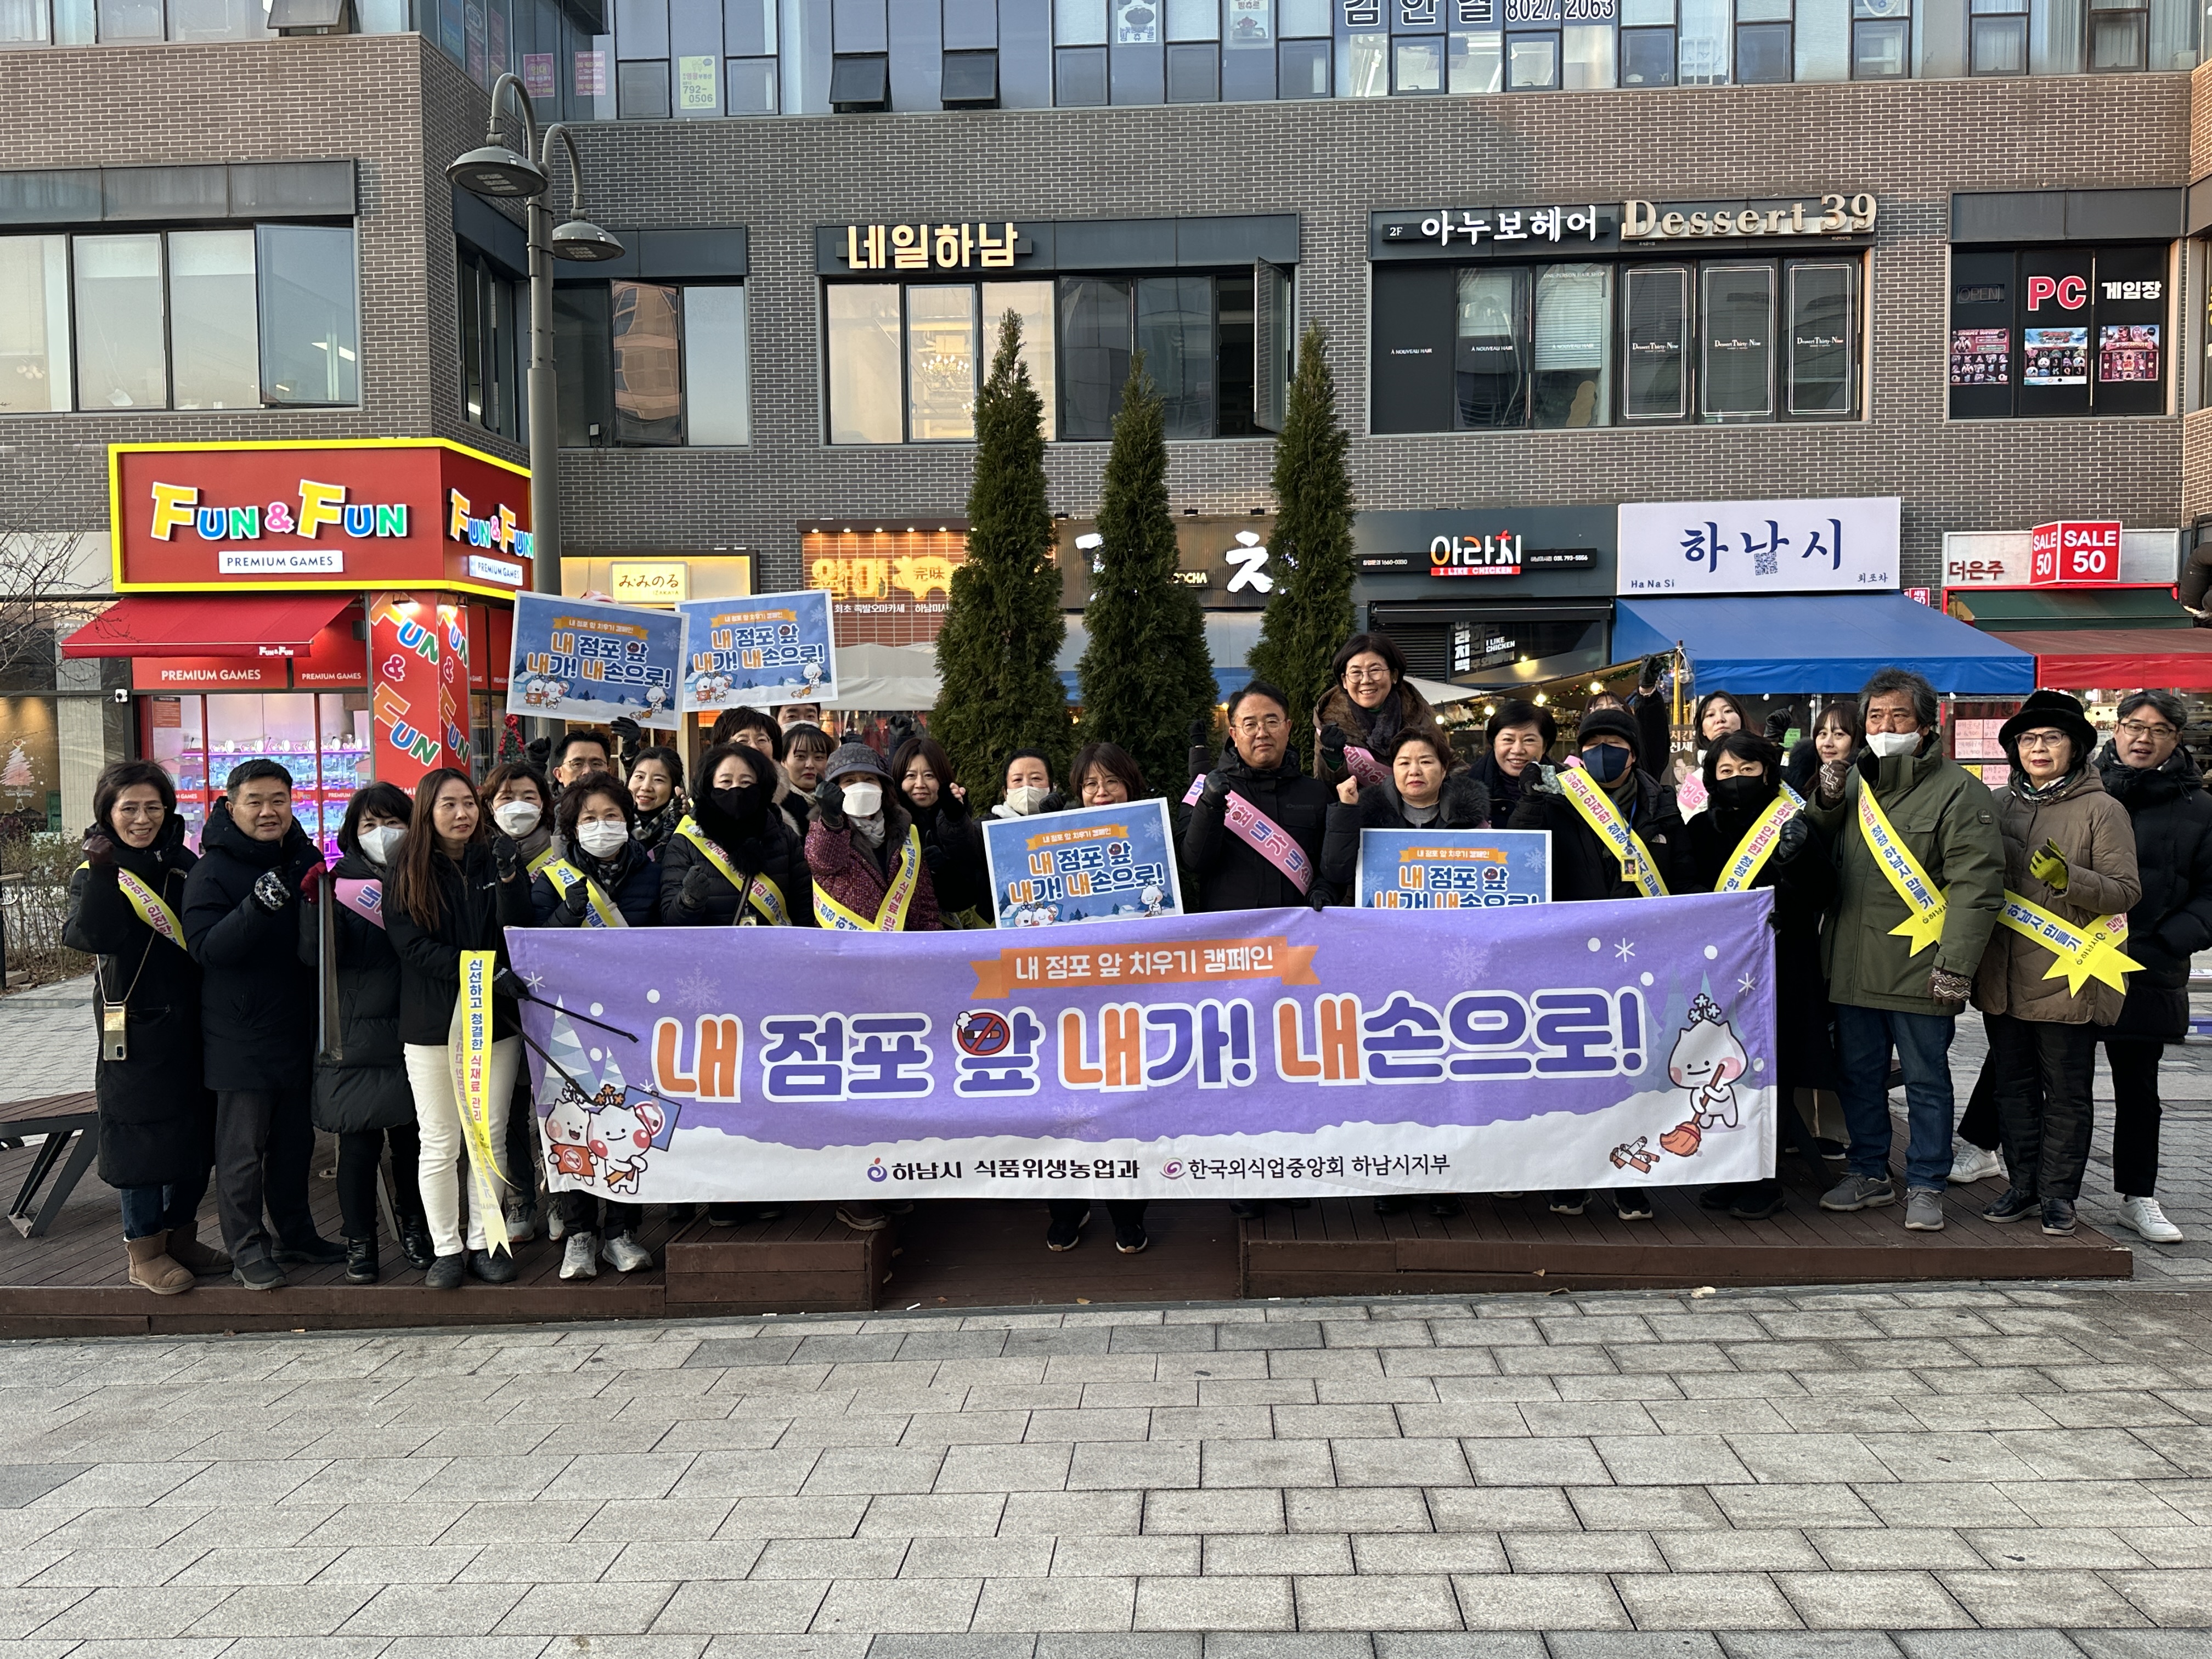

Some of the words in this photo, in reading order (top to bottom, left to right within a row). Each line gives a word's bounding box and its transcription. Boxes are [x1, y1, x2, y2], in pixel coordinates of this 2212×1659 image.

[683, 85, 707, 94] 792-
[689, 94, 713, 103] 0506
[1390, 227, 1403, 236] 2F
[1421, 205, 1596, 246] 아누보헤어
[1624, 199, 1806, 238] Dessert
[1820, 193, 1877, 231] 39
[848, 222, 1018, 269] 네일하남
[1959, 286, 1999, 302] OPEN
[2028, 275, 2087, 312] PC
[2102, 280, 2162, 300] 게임장
[1430, 530, 1522, 566] 아라치
[2033, 531, 2057, 551] SALE
[2063, 530, 2117, 548] SALE
[227, 557, 286, 567] PREMIUM
[289, 556, 334, 567] GAMES
[478, 561, 503, 576] PREMIUM
[503, 567, 521, 579] GAMES
[1472, 566, 1513, 575] CHICKEN
[1950, 560, 2005, 580] 더은주
[2036, 552, 2052, 575] 50
[2072, 550, 2106, 573] 50
[835, 605, 851, 613] 최초
[854, 604, 905, 613] 족발오마카세
[616, 625, 634, 634] 캠페인
[712, 629, 732, 650] 내
[736, 627, 775, 648] 점포
[778, 624, 799, 645] 앞
[1490, 636, 1505, 645] LIKE
[552, 633, 573, 654] 내
[579, 635, 621, 659] 점포
[626, 641, 648, 663] 앞
[693, 650, 738, 673] 내가!
[742, 644, 825, 669] 내손으로!
[1486, 640, 1515, 653] CHICKEN
[161, 670, 217, 681] PREMIUM
[219, 669, 261, 680] GAMES
[528, 653, 577, 678] 내가!
[583, 659, 672, 688] 내손으로!
[1670, 730, 1695, 741] 치킨
[1051, 833, 1063, 842] 점포
[1073, 831, 1091, 840] 치우기
[1092, 828, 1111, 837] 캠페인
[1250, 820, 1288, 856] 내가
[1583, 794, 1613, 825] 안전한
[1606, 822, 1628, 845] 청정
[1644, 874, 1663, 896] 만들
[1747, 825, 1777, 857] 안전한
[1028, 851, 1053, 877] 내
[1057, 845, 1105, 873] 점포
[1107, 841, 1132, 867] 앞
[1469, 850, 1489, 859] 캠페인
[1732, 855, 1754, 878] 청정
[1871, 825, 1889, 847] 청정
[1883, 845, 1912, 879] 하남시
[1905, 877, 1935, 910] 만들기
[1009, 875, 1064, 905] 내가!
[1066, 862, 1165, 897] 내손으로!
[1399, 865, 1425, 890] 내
[1429, 866, 1477, 891] 점포
[1483, 866, 1509, 892] 앞
[357, 884, 382, 909] 내
[887, 882, 909, 915] 식재료
[148, 905, 173, 935] 안전한
[2006, 903, 2045, 931] 하남시
[2042, 924, 2083, 952] 만들기
[1016, 957, 1039, 981] 내
[1046, 955, 1092, 980] 점포
[1098, 953, 1123, 978] 앞
[1130, 950, 1197, 977] 치우기
[1204, 945, 1274, 974] 캠페인
[469, 960, 483, 1008] 신선하고
[471, 1013, 483, 1051] 청결한
[652, 1013, 743, 1103] 내
[760, 1011, 934, 1103] 점포
[953, 1006, 1046, 1098] 앞
[1058, 997, 1257, 1093] 내가!
[1273, 987, 1648, 1087] 내손으로!
[470, 1055, 482, 1092] 식재료
[471, 1097, 482, 1122] 관리
[891, 1161, 962, 1181] 하남시
[974, 1158, 1140, 1180] 식품위생농업과
[1187, 1155, 1344, 1180] 한국외식업중앙회
[1352, 1153, 1450, 1177] 하남시지부
